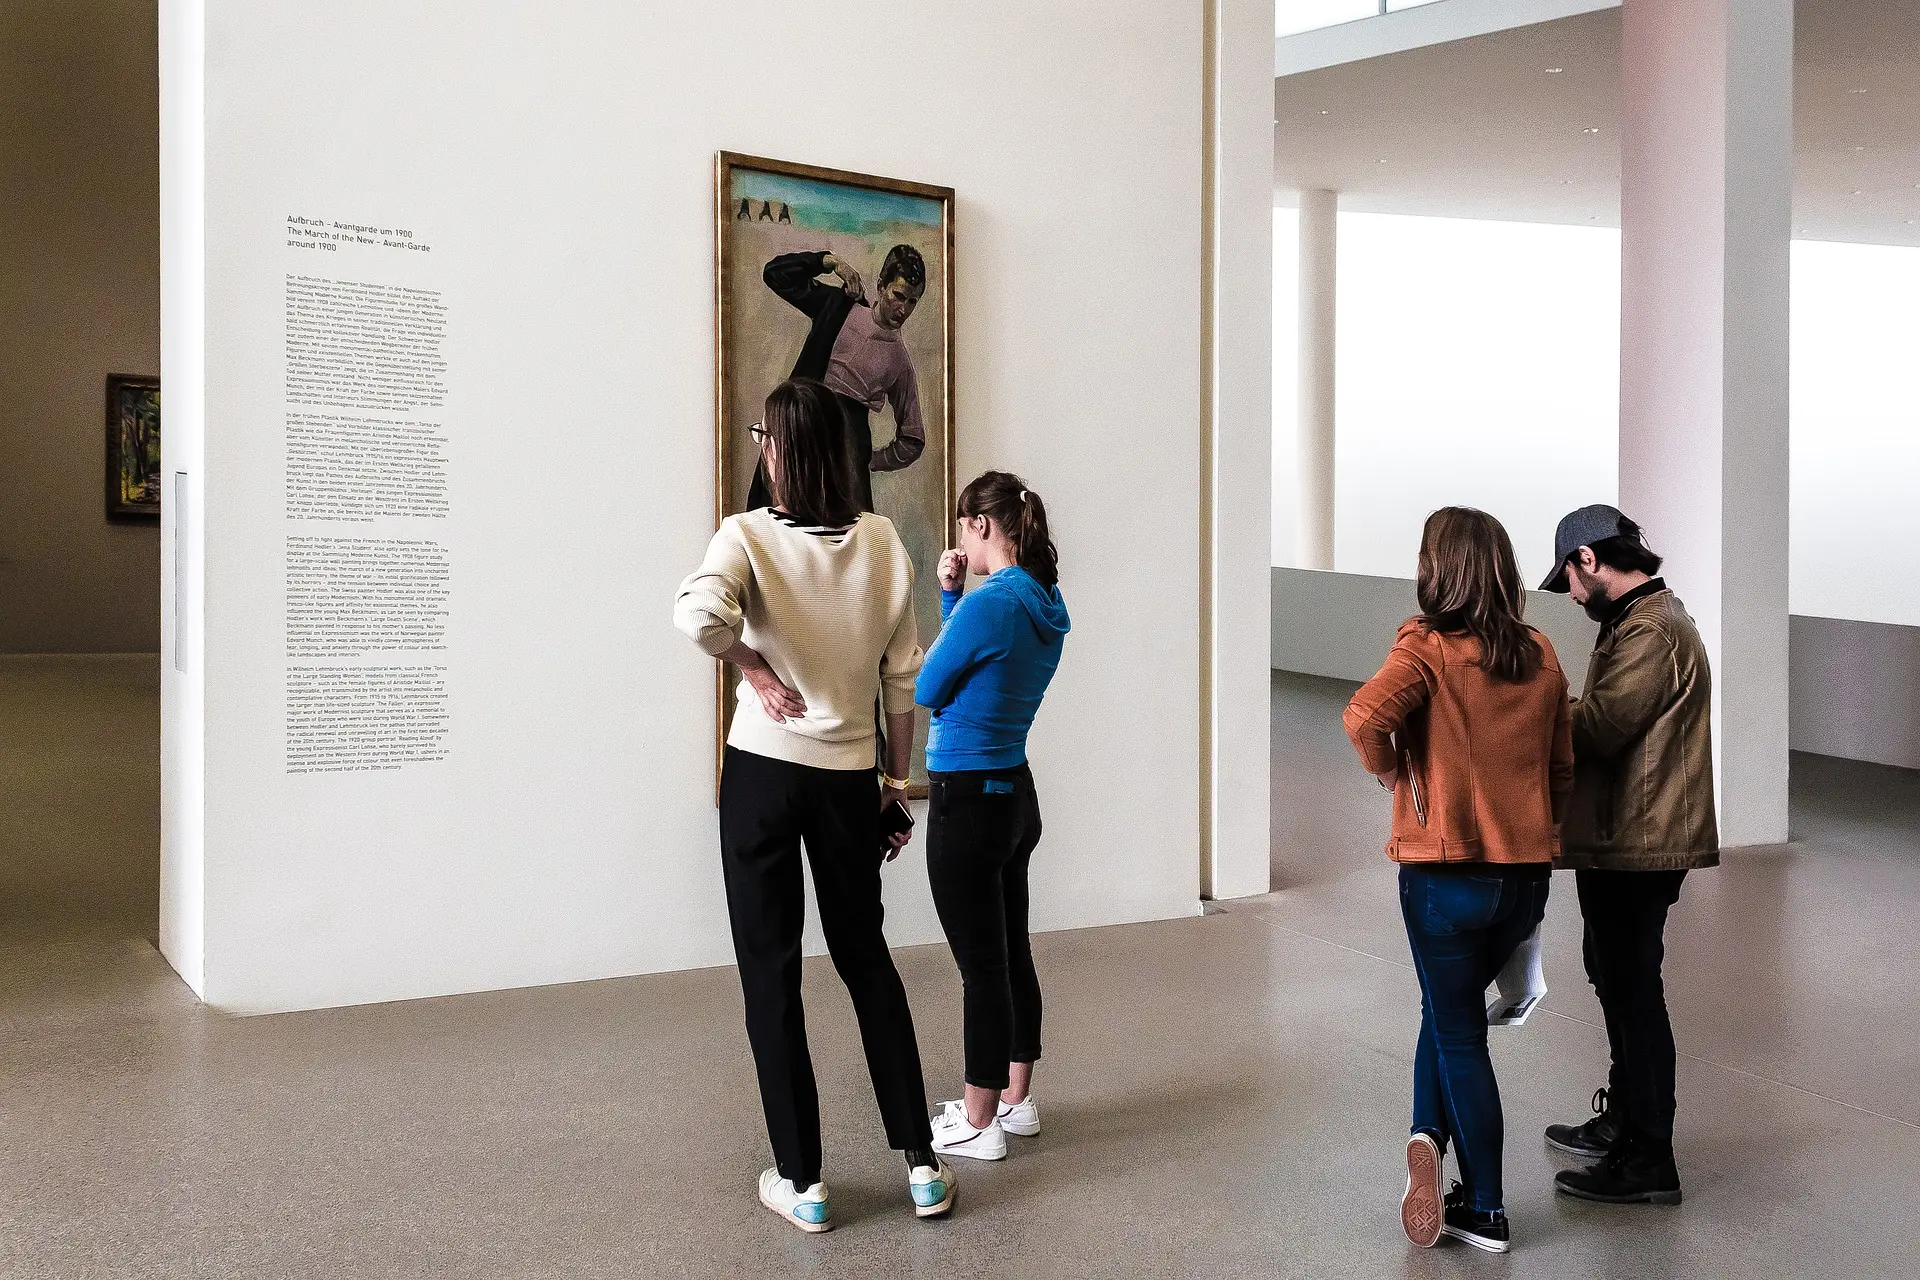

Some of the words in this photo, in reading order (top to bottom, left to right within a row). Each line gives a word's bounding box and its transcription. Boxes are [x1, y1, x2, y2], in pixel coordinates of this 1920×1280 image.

[287, 215, 324, 227] Aufbruch
[333, 221, 378, 234] Avantgarde
[380, 228, 393, 236] um
[395, 228, 413, 239] 1900
[287, 226, 302, 236] The
[304, 228, 330, 239] March
[331, 231, 341, 240] of
[341, 233, 355, 243] the
[356, 235, 374, 245] New
[383, 239, 431, 252] Avant-Garde
[287, 239, 316, 249] around
[318, 242, 337, 252] 1900
